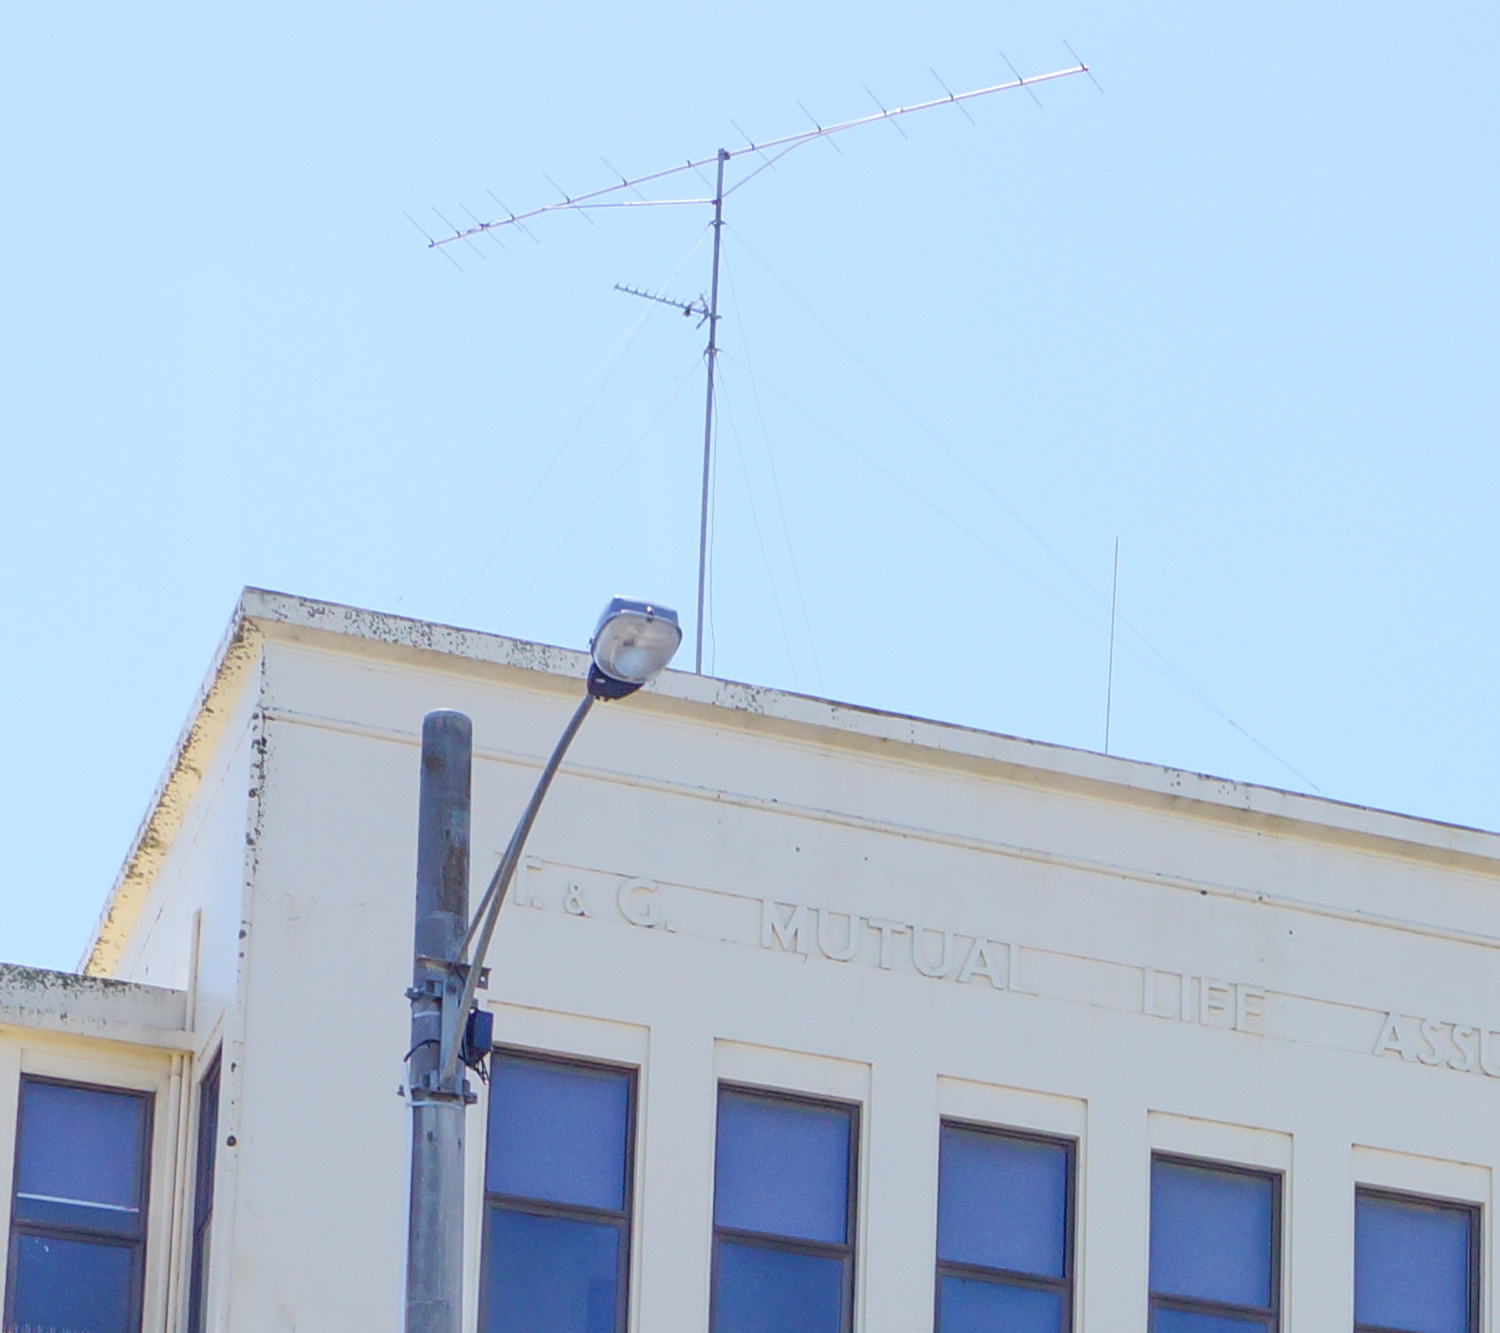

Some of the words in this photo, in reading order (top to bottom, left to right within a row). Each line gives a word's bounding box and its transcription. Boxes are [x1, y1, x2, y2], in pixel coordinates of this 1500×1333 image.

[562, 881, 591, 918] &
[760, 898, 1038, 997] MUTUAL
[1140, 966, 1267, 1036] LIFE
